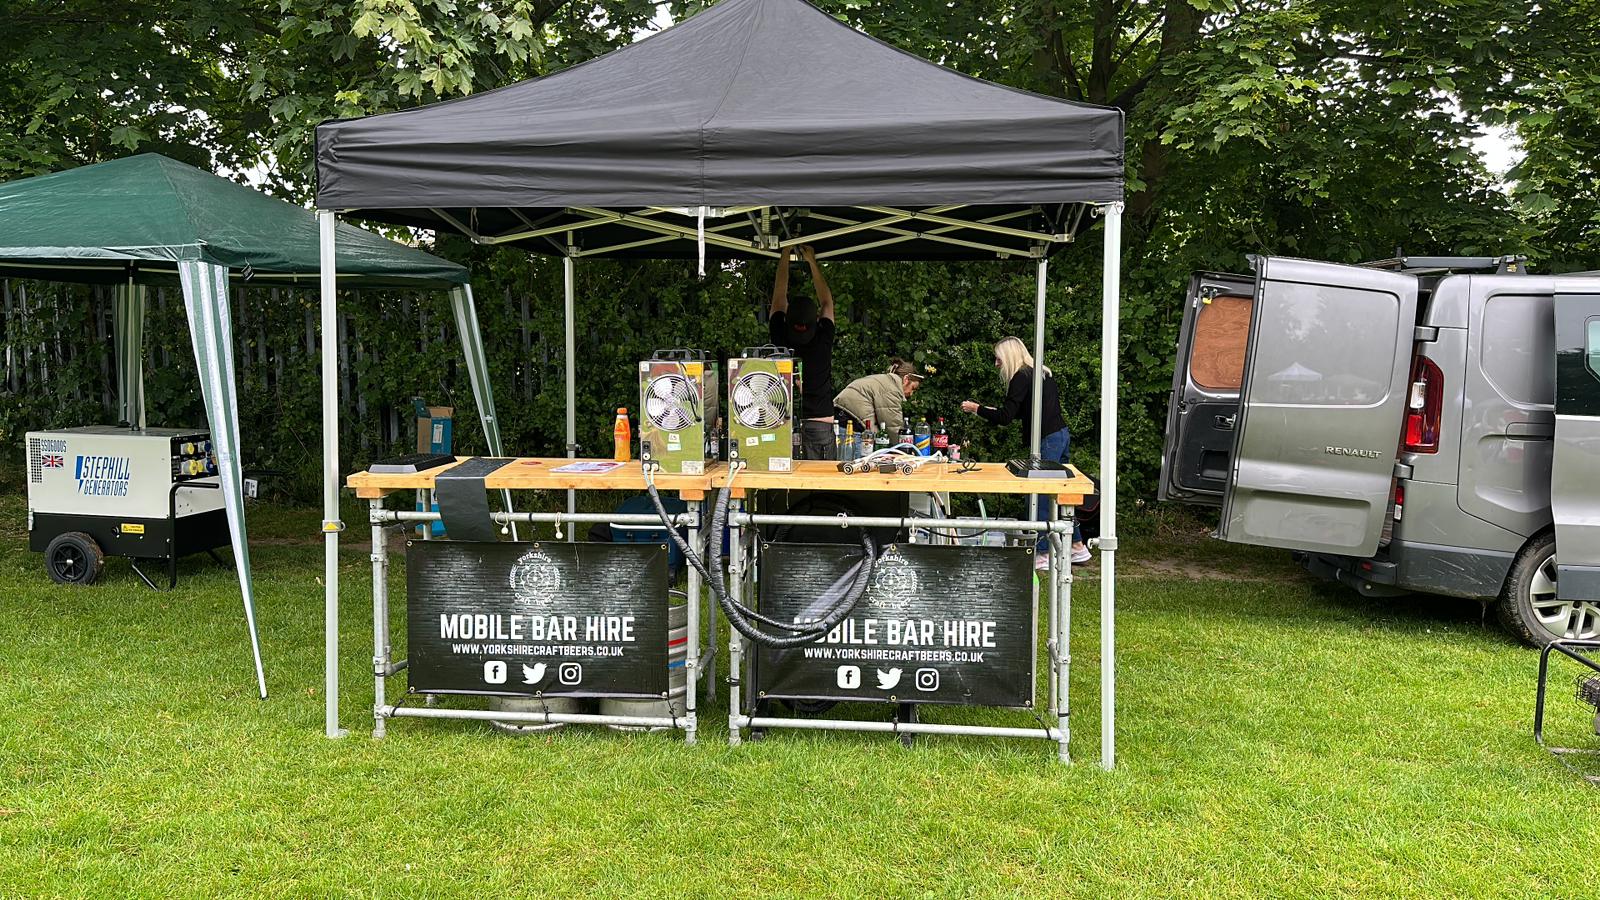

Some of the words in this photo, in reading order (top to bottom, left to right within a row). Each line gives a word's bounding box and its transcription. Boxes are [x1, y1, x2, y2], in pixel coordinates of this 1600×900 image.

[1325, 446, 1382, 459] RENAULT
[83, 456, 130, 480] STEPHILL
[84, 480, 129, 497] GENERATORS
[517, 551, 552, 565] yorkshire
[874, 554, 909, 568] yorkshire
[440, 613, 524, 640] MOBILE
[532, 616, 577, 641] BAR
[585, 616, 636, 642] HIRE
[887, 619, 934, 646] BAR
[943, 621, 997, 648] HIRE
[452, 643, 624, 657] WWW.YORKSHIRECRAFTBEERS.CO.UK
[804, 648, 984, 663] WWW.YORKSHIRECRAFTBEERS.CO.UK
